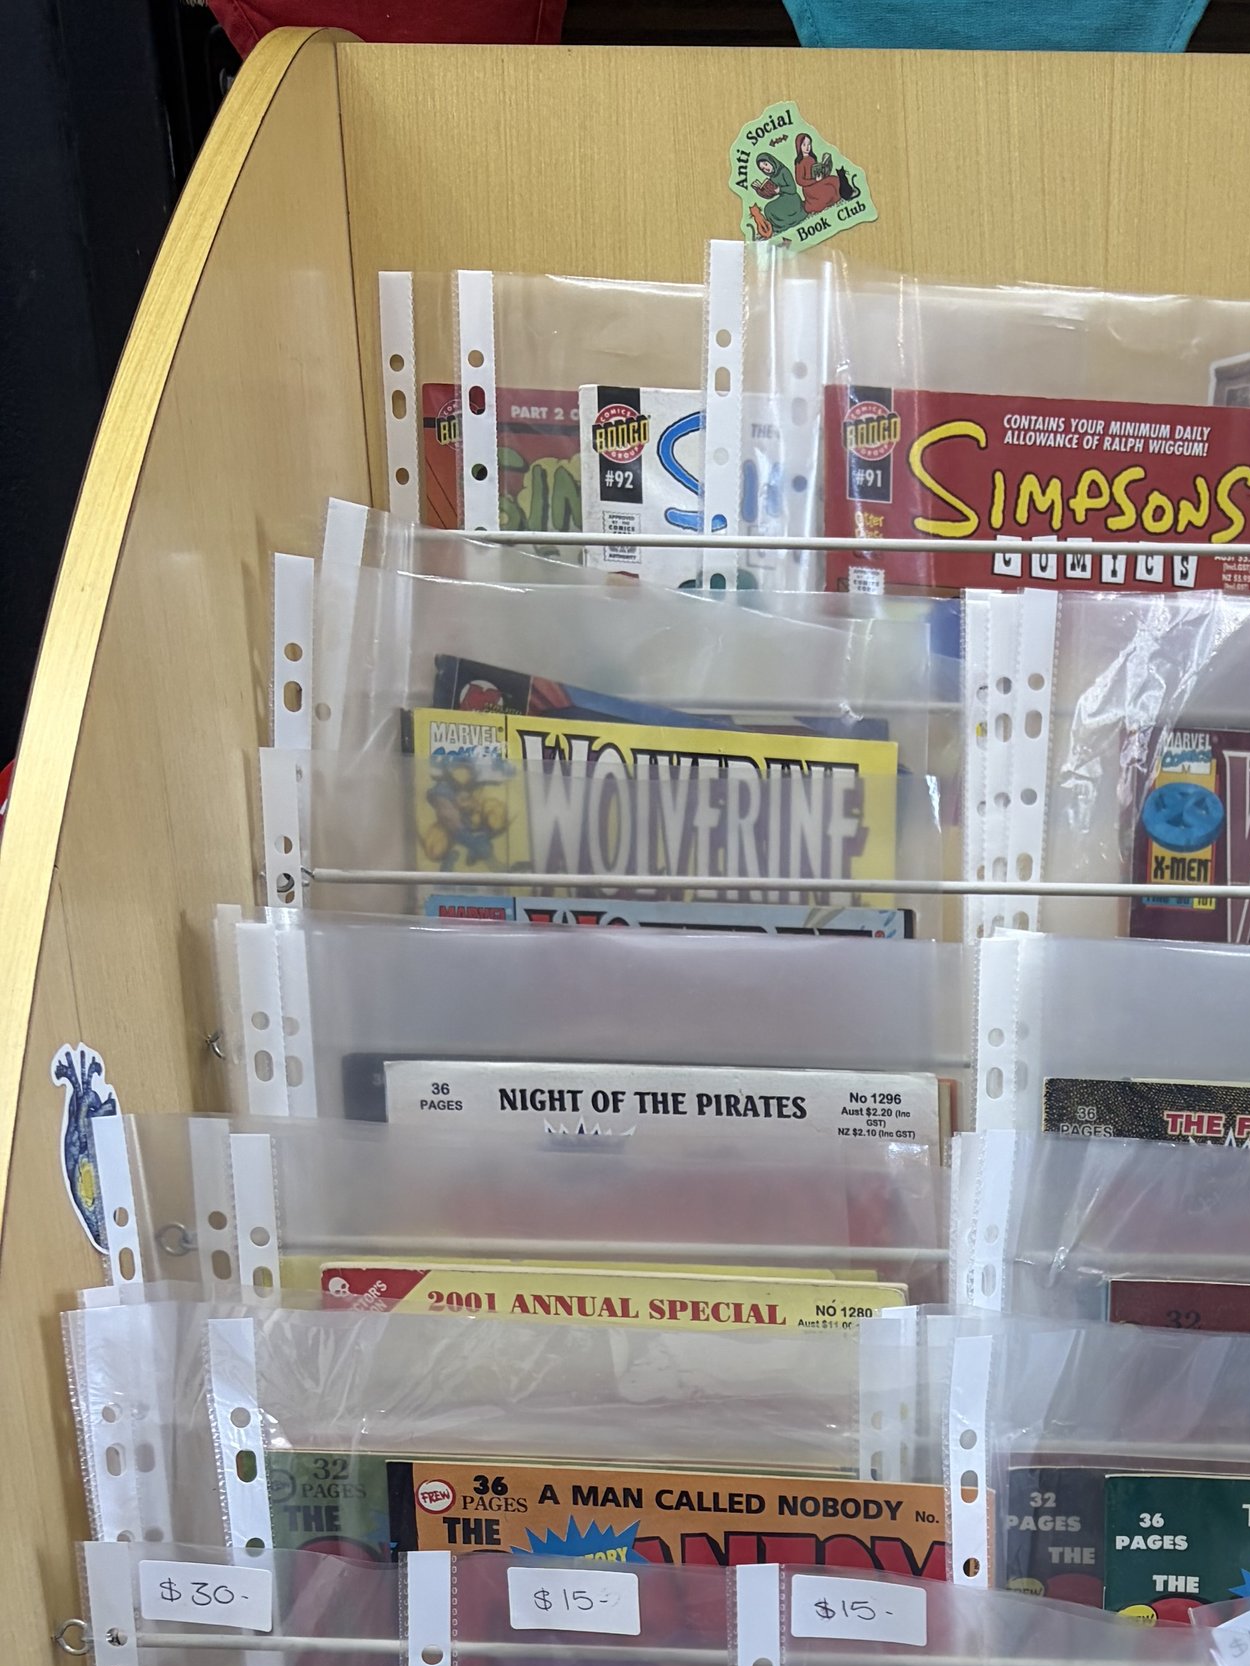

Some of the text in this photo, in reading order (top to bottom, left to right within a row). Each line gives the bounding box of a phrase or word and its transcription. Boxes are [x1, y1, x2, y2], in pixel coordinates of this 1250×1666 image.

[735, 109, 794, 190] Anti Social
[797, 201, 866, 242] Book Club
[511, 405, 548, 419] PART
[592, 414, 649, 453] BONGO
[1002, 414, 1211, 442] CONTAINS YOUR MINIMUM DAILY
[1003, 430, 1208, 457] ALLOWANCE OF RALPH WIGGUM!
[605, 470, 634, 489] #92
[431, 721, 501, 746] MARVEL
[517, 729, 867, 905] WOLVERINE
[1153, 855, 1211, 883] X-MEN
[431, 1083, 450, 1095] 36
[849, 1092, 902, 1105] No 1296
[420, 1100, 463, 1112] PAGES
[499, 1088, 808, 1121] NIGHT OF THE PIRATES
[841, 1106, 893, 1118] Aust $2.20
[1076, 1107, 1096, 1121] 36
[838, 1128, 850, 1136] NZ
[1163, 1110, 1225, 1137] THE
[427, 1289, 787, 1327] 2001 ANNUAL SPECIAL
[840, 1307, 873, 1318] 1280
[313, 1458, 349, 1480] 32
[473, 1475, 508, 1496] 36
[462, 1496, 528, 1513] PAGES
[538, 1484, 940, 1524] A MAN CALLED NOBODY No.
[284, 1505, 342, 1532] THE
[1138, 1513, 1165, 1528] 36
[443, 1517, 501, 1545] THE
[1115, 1535, 1188, 1550] PAGES
[1049, 1547, 1096, 1565] THE
[1152, 1575, 1200, 1593] THE
